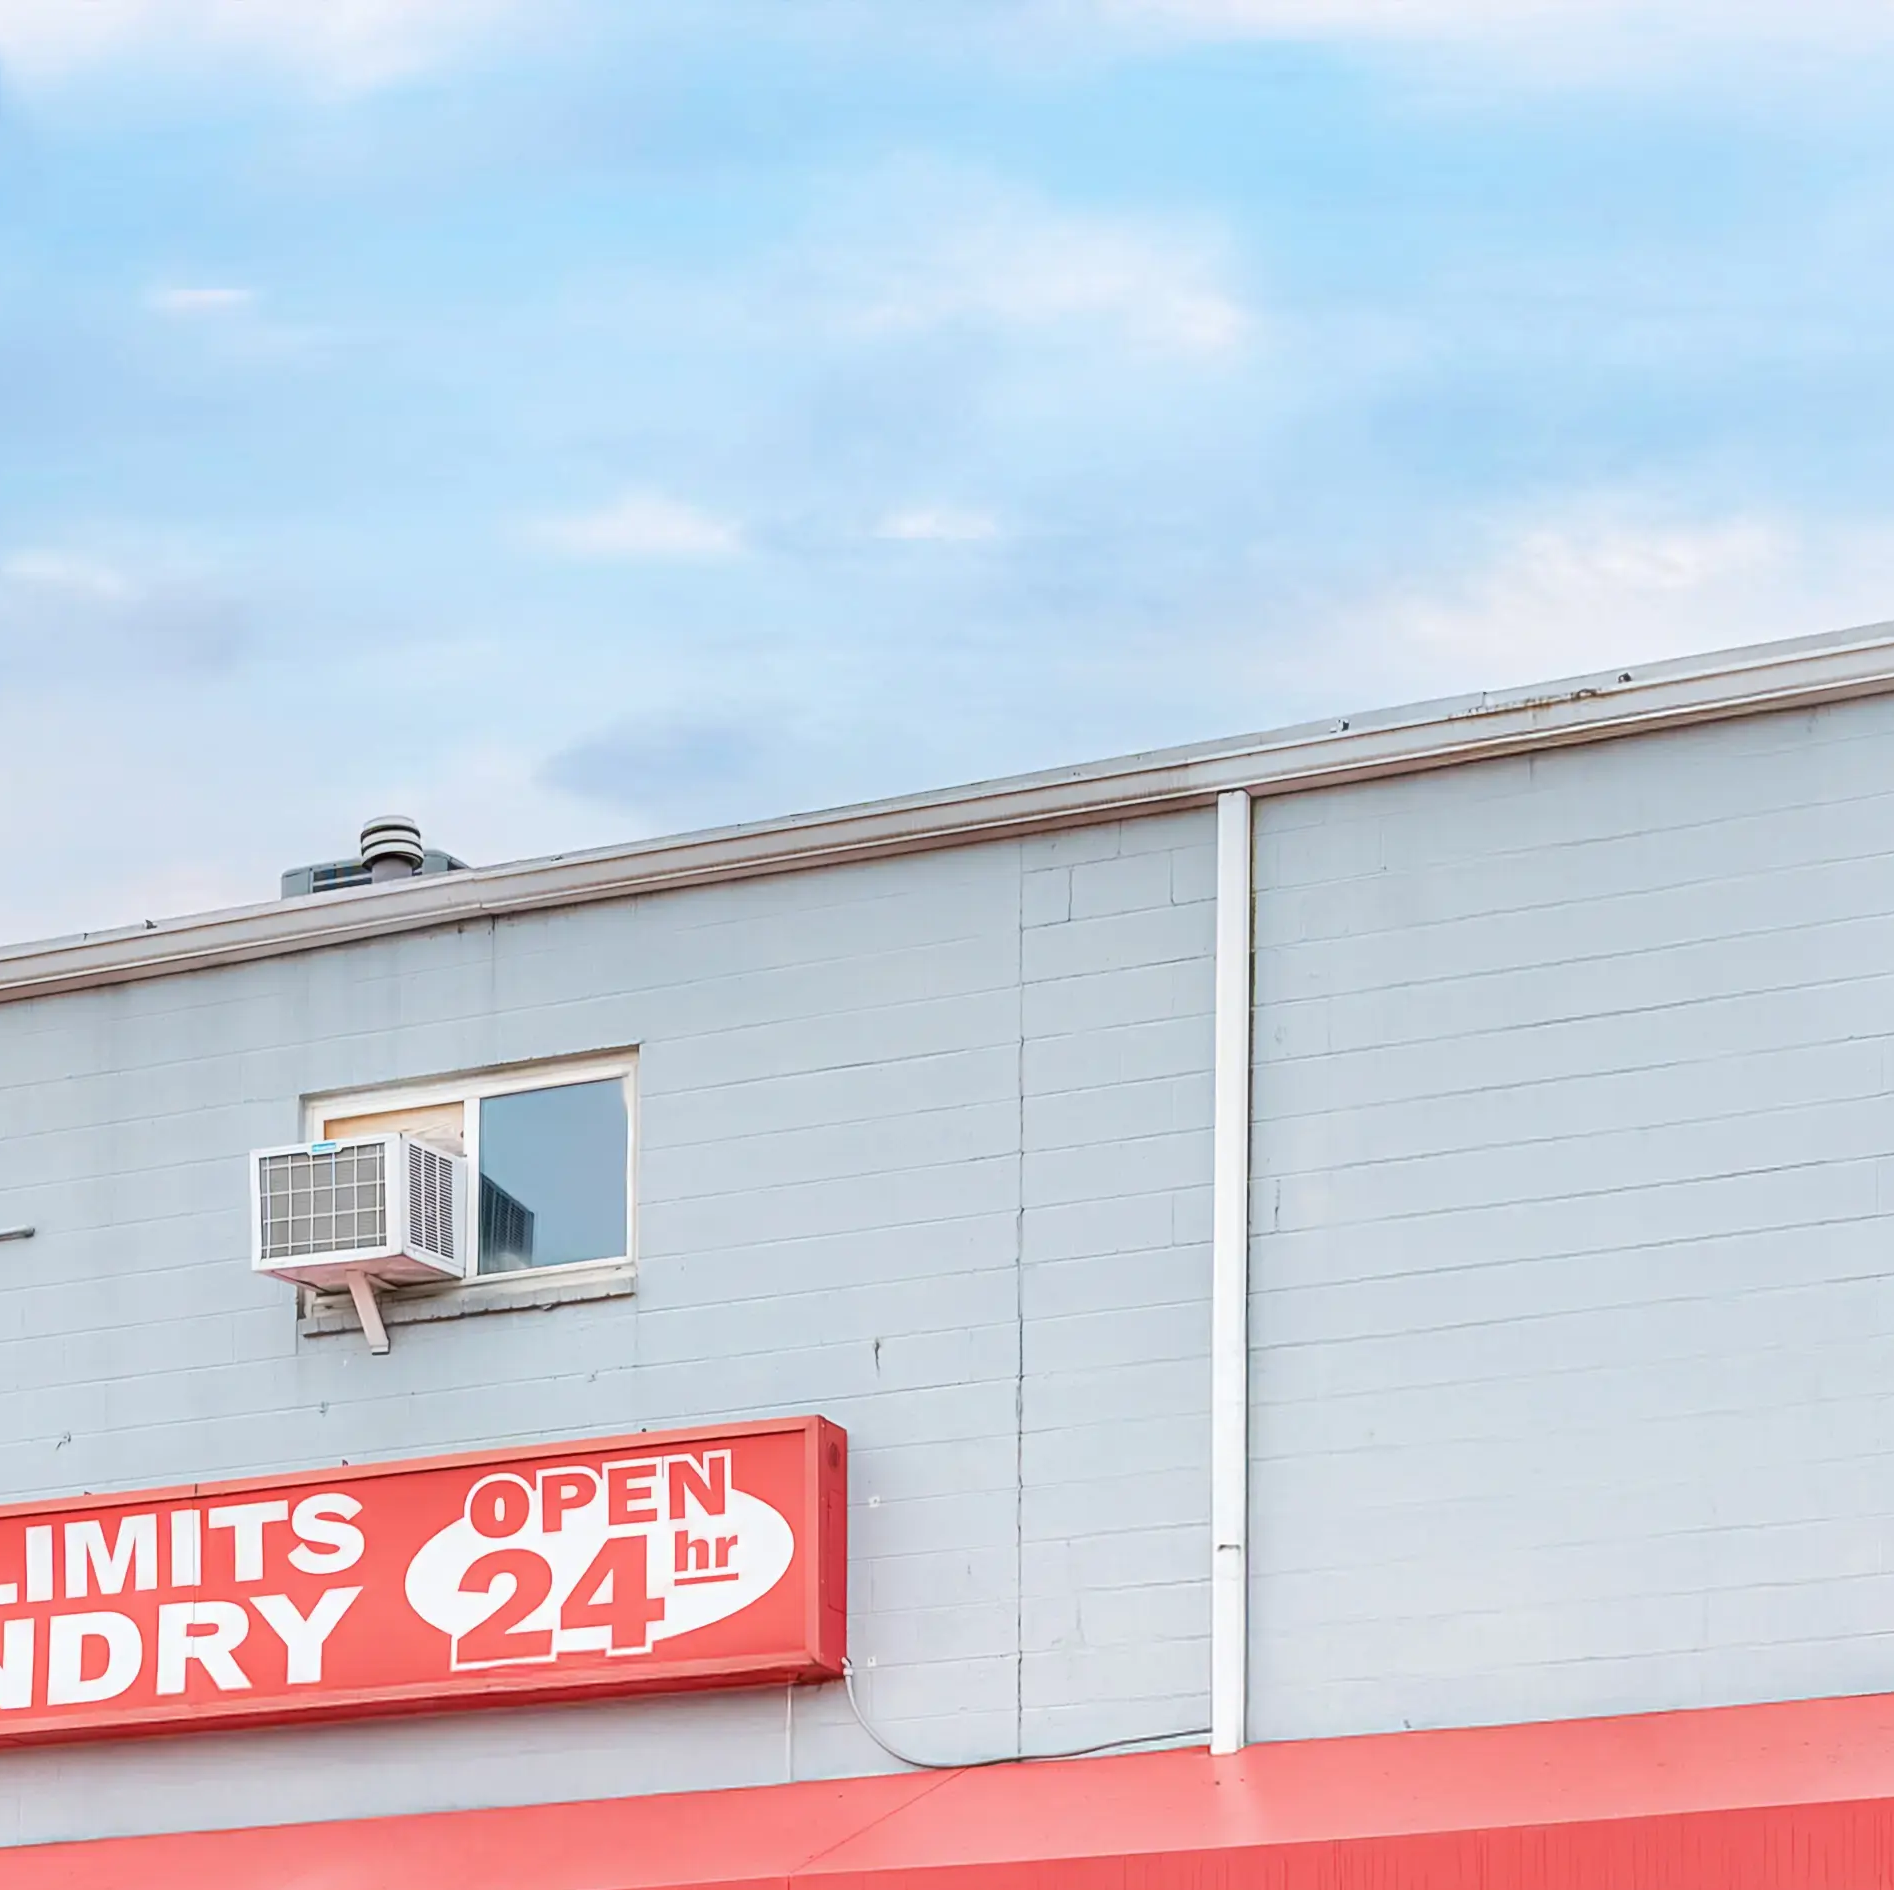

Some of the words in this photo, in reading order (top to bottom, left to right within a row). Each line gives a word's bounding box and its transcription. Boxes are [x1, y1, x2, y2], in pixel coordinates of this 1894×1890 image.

[469, 1457, 728, 1539] OPEN
[455, 1533, 666, 1665] 24
[672, 1530, 739, 1574] hr
